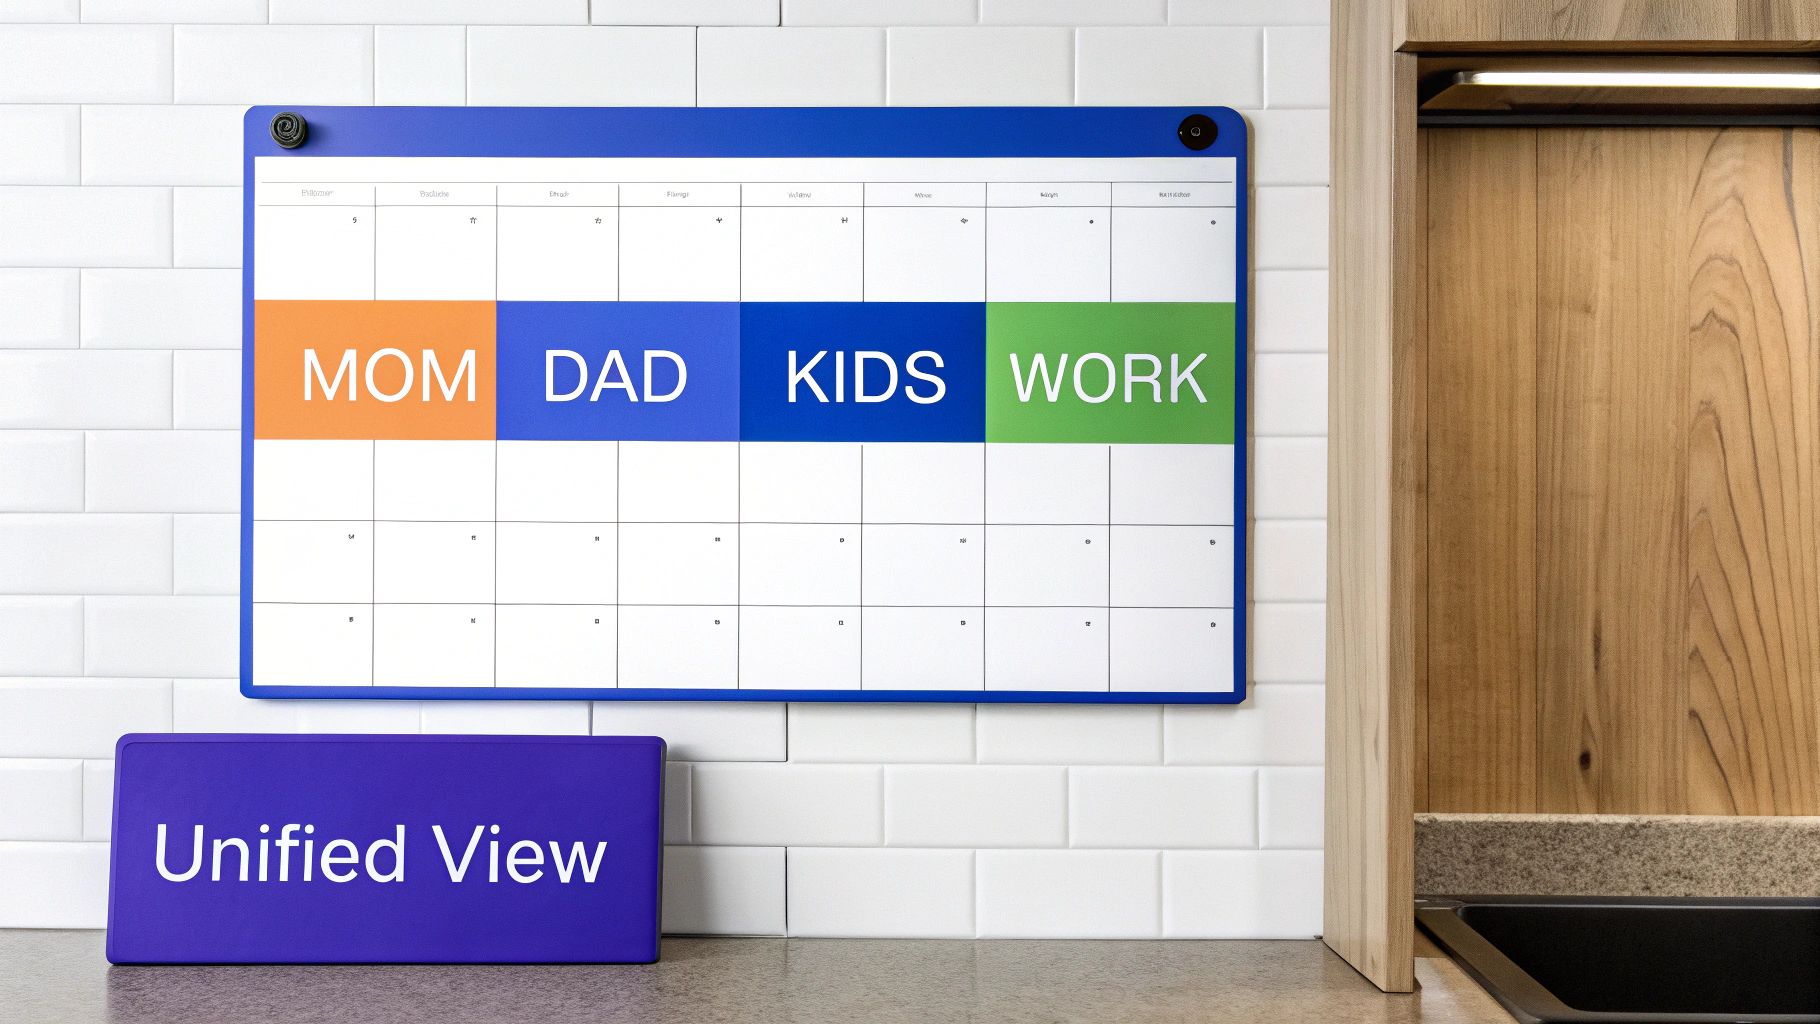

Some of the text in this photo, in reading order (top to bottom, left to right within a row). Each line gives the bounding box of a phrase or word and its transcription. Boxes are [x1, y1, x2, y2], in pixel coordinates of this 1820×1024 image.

[304, 347, 476, 402] MOM
[545, 349, 687, 402] DAD
[788, 350, 946, 404] KIDS
[1009, 352, 1208, 404] WORK
[155, 823, 608, 884] Unified View
